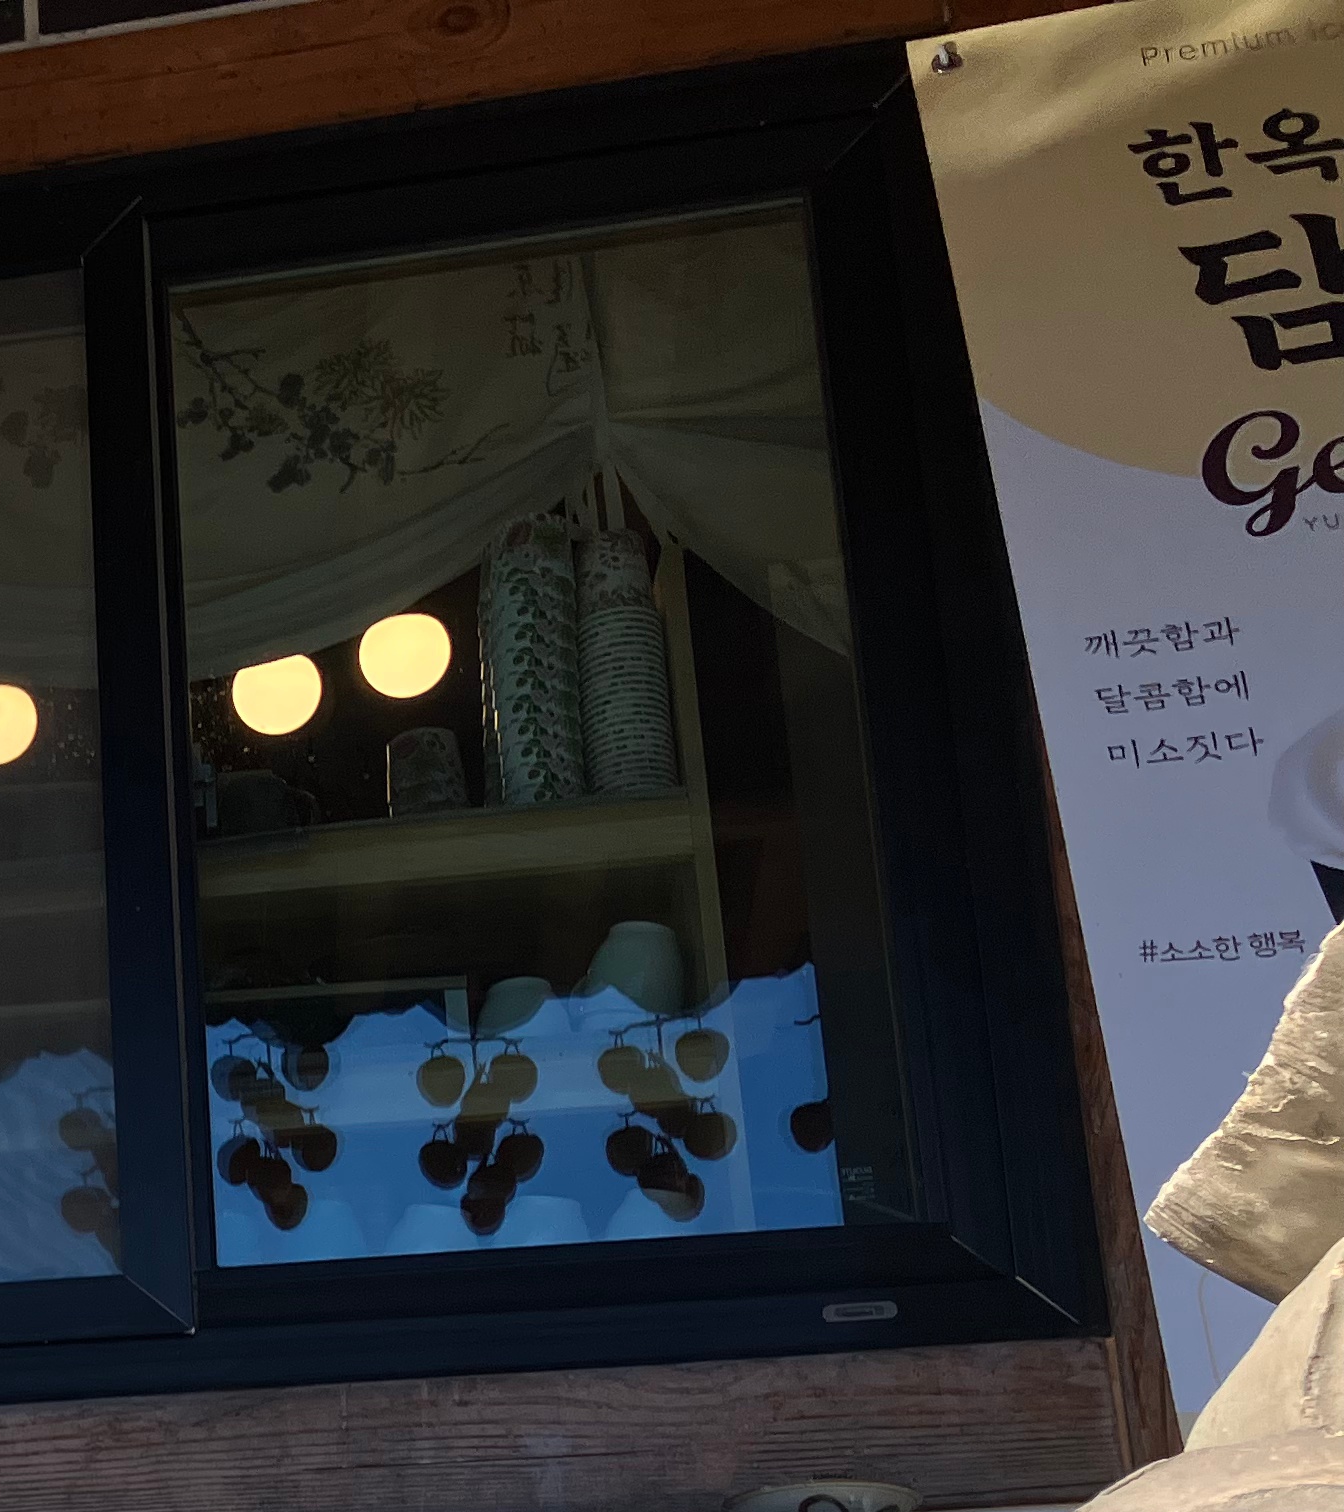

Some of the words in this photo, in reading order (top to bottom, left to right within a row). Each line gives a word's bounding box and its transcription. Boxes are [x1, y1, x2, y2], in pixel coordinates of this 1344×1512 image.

[1141, 28, 1296, 66] Premium
[1127, 108, 1344, 206] 한옥
[1084, 616, 1240, 659] 깨끗함과
[1094, 670, 1249, 715] 달콤함에
[1107, 726, 1264, 769] 미소짓다
[1139, 935, 1242, 963] #소소한
[1248, 930, 1306, 958] 행복
